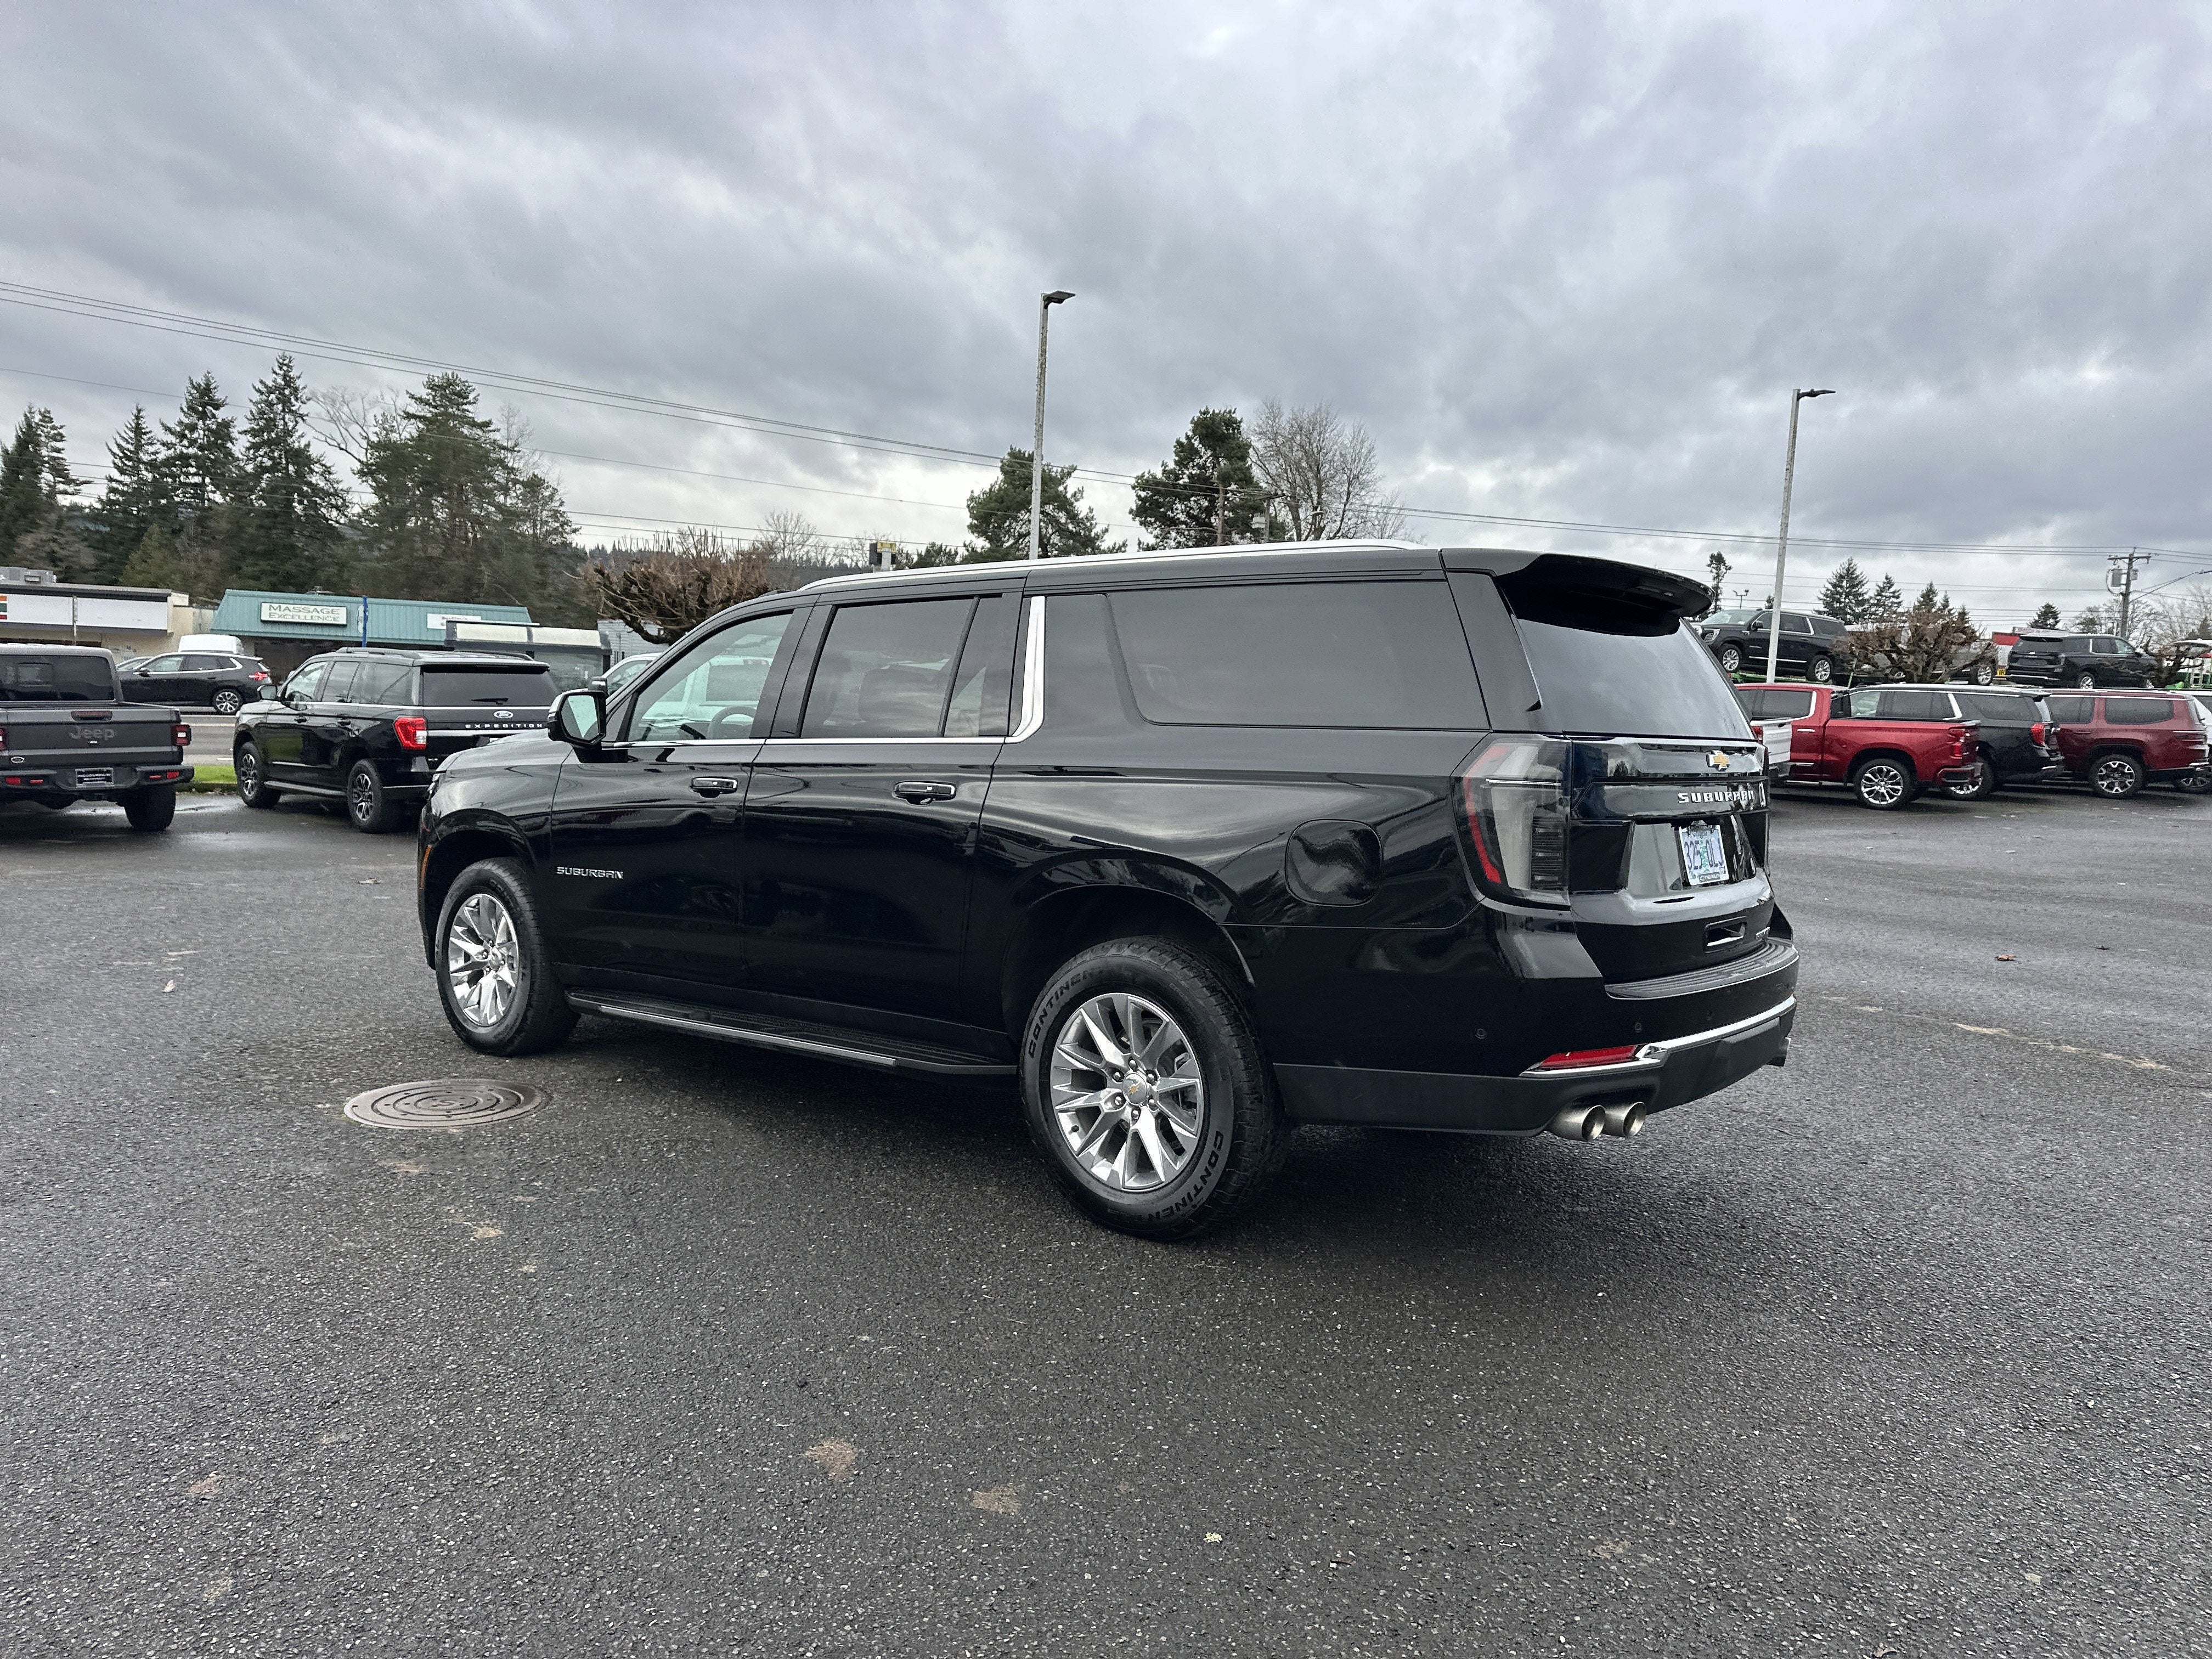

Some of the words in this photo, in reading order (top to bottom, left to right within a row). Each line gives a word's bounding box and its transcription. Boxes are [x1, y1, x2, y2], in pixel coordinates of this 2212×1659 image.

[269, 605, 340, 614] MASSAGE
[269, 612, 340, 622] EXCELLENCE
[68, 725, 115, 741] Jeep
[1677, 790, 1754, 804] SUBURBAN
[556, 866, 623, 879] SUBURBAN
